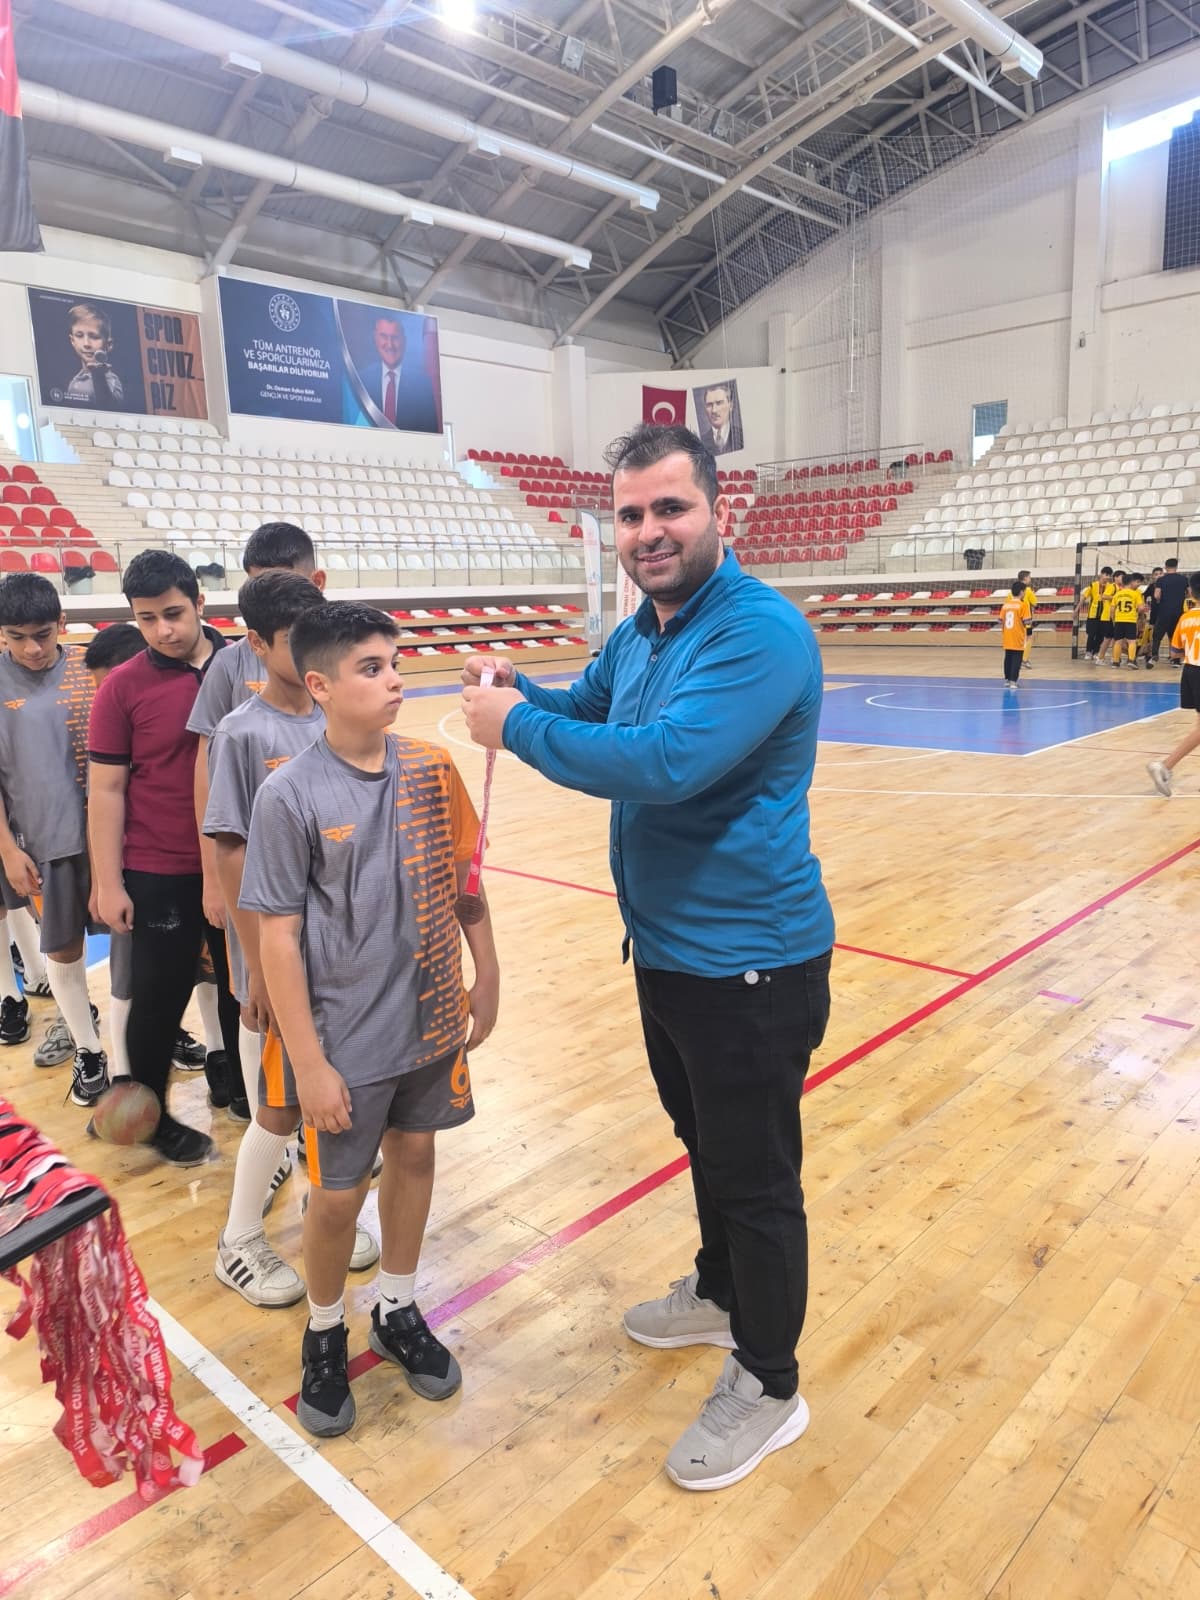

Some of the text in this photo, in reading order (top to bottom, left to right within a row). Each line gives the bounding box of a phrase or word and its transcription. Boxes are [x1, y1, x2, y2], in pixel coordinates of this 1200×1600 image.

[143, 313, 183, 344] SPOR
[252, 339, 321, 358] TÜM ANTRENÖR
[147, 347, 195, 379] CUYUZ
[243, 348, 331, 370] VE SPORCULARIMIZA
[248, 361, 329, 379] BAŞARILAR DİLİYORUM
[150, 380, 176, 410] BİZ
[1116, 601, 1133, 613] 15
[1005, 611, 1014, 629] 8
